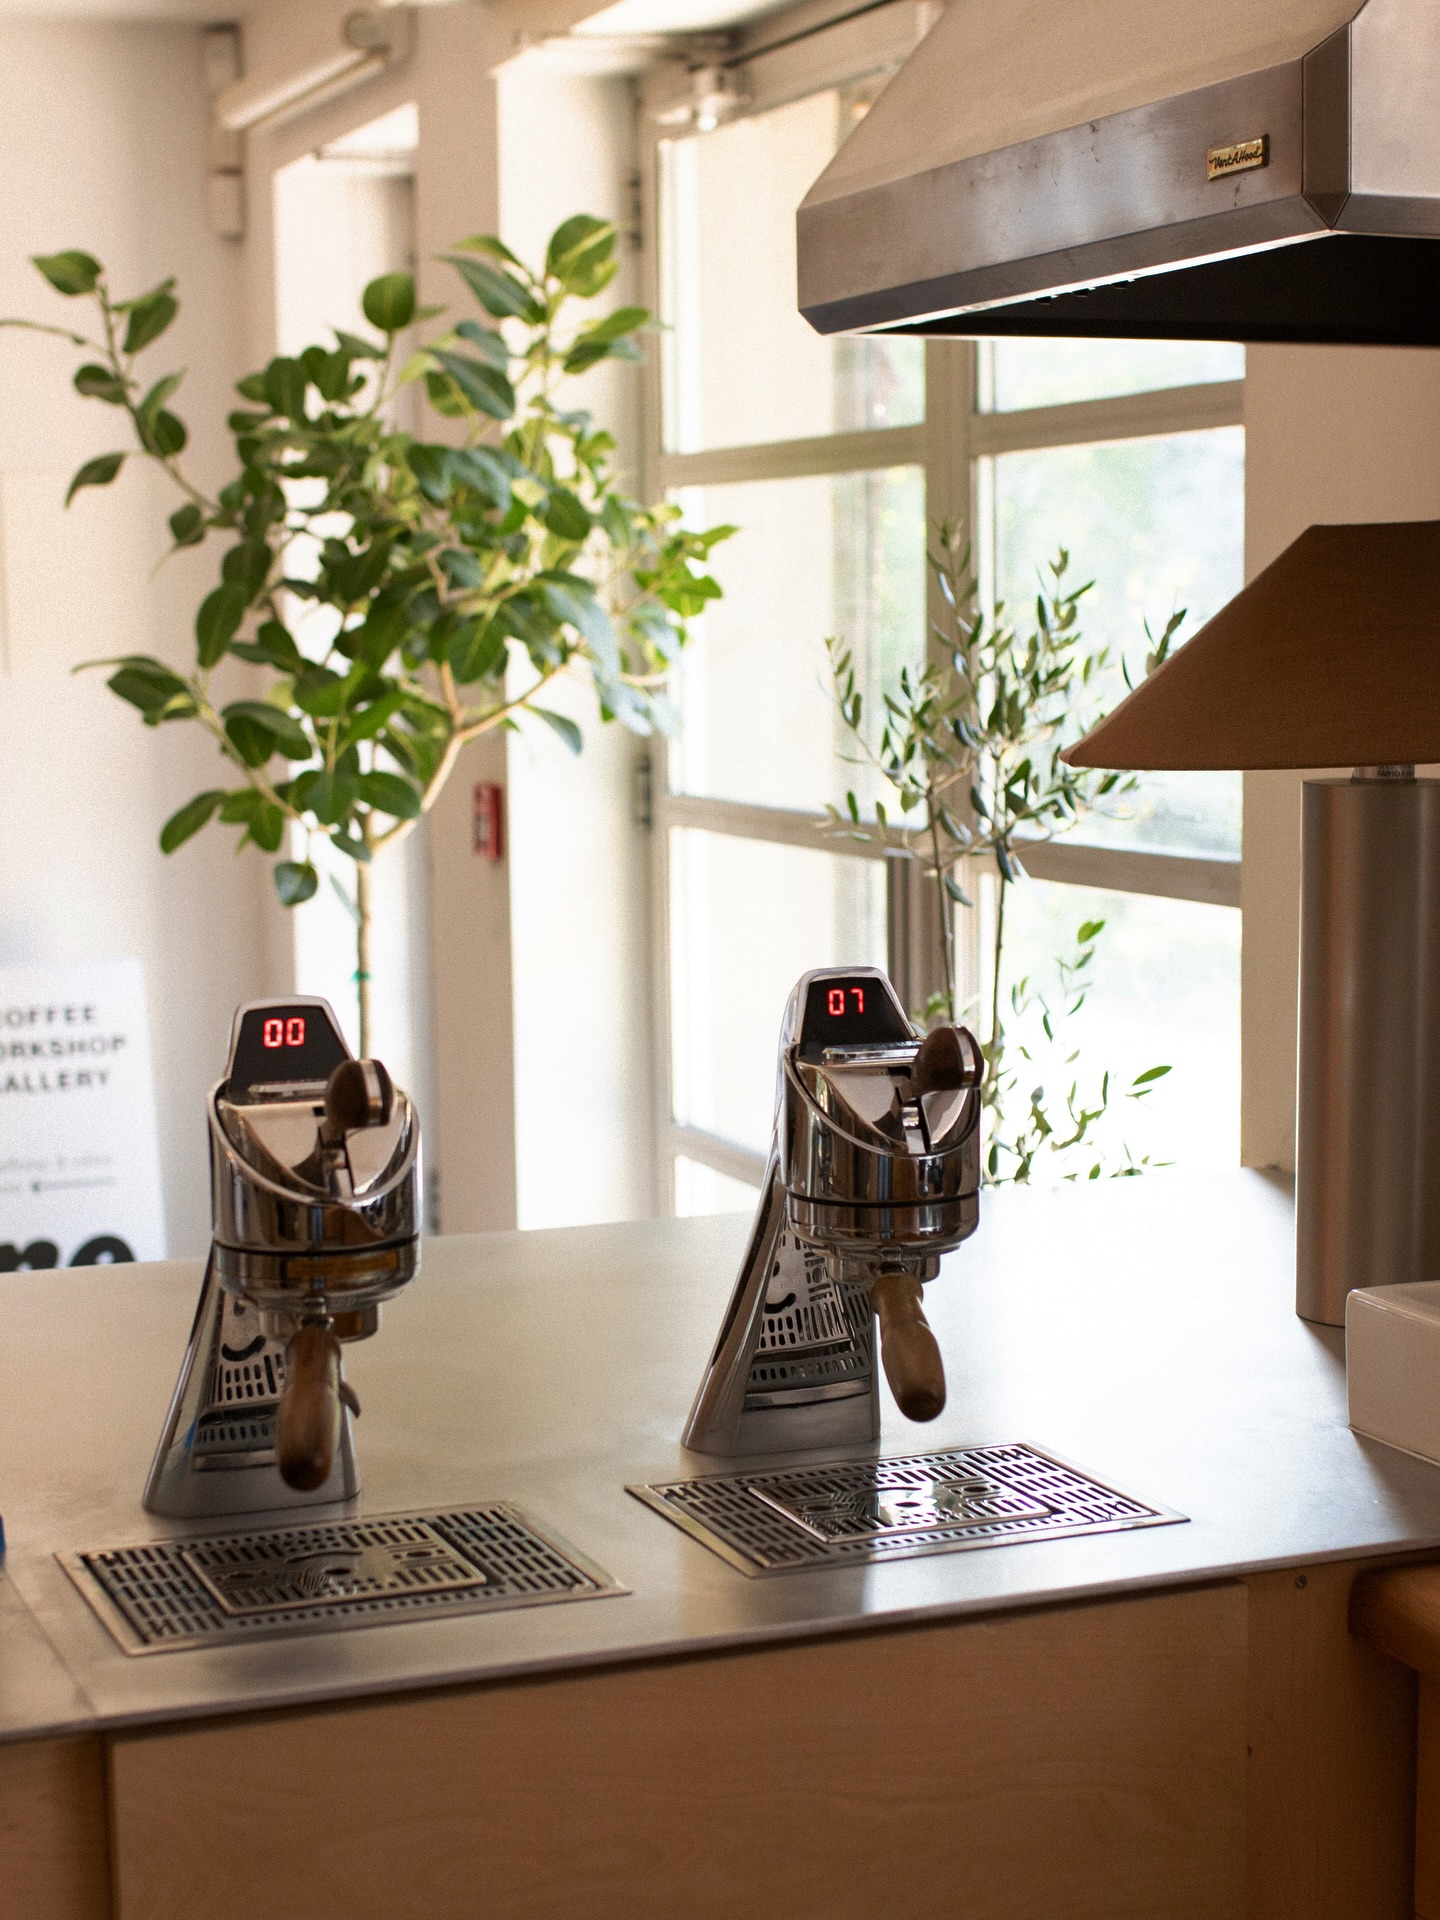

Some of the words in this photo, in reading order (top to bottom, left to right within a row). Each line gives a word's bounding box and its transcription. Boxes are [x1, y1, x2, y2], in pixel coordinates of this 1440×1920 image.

[828, 987, 864, 1016] 07
[0, 1005, 96, 1028] OFFEE
[263, 1017, 305, 1048] 00
[0, 1069, 110, 1094] ALLERY
